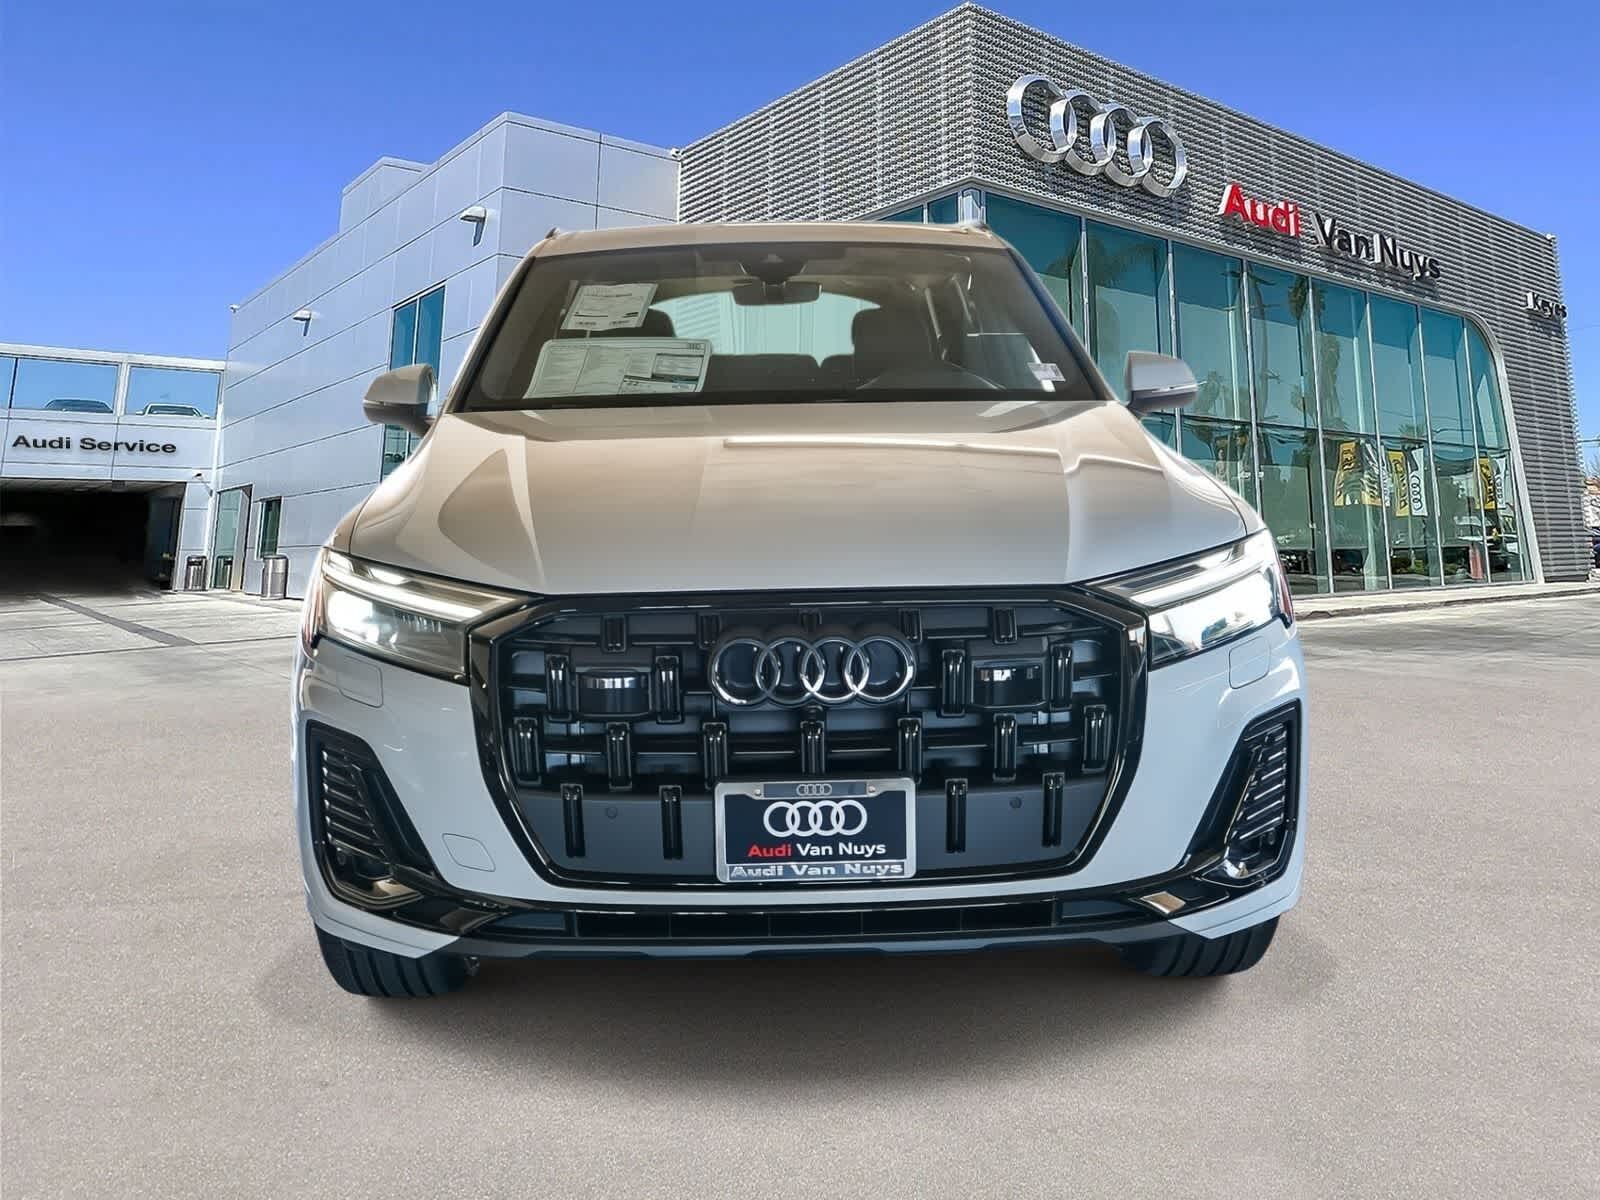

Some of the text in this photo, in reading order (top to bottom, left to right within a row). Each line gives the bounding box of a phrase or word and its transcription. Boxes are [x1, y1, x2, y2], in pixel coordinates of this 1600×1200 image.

[1217, 182, 1441, 282] Audi Van Nuys
[1526, 292, 1568, 319] Keyes
[12, 434, 178, 454] Audi Service
[747, 842, 886, 858] Audi Van Nuys
[730, 863, 904, 878] Audi Van Nuys
